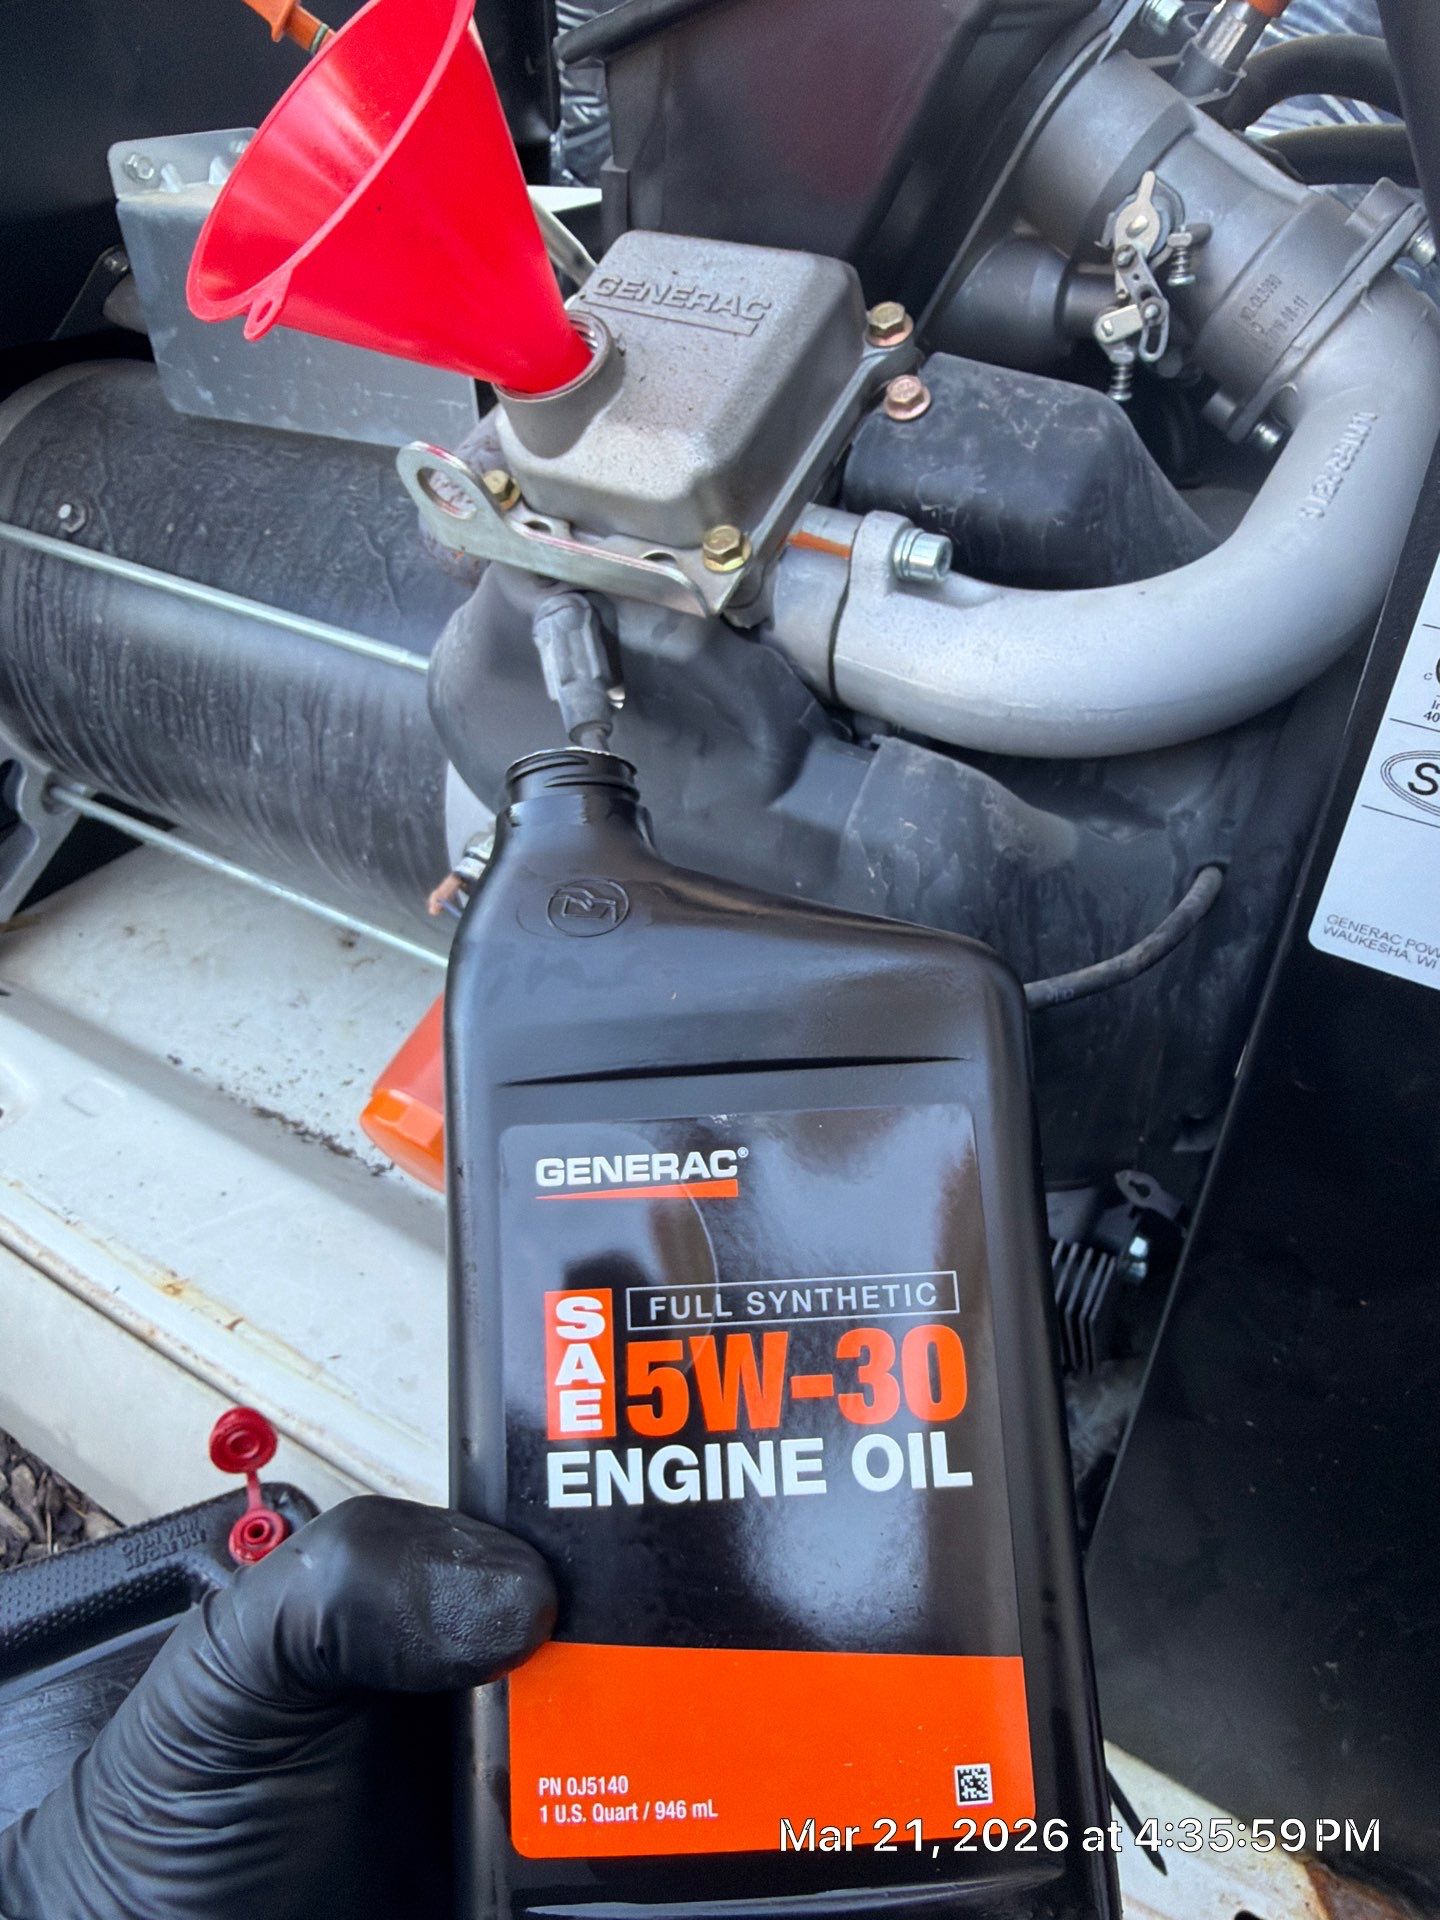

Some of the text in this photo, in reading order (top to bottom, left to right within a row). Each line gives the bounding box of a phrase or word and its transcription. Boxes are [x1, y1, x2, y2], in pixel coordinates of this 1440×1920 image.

[593, 276, 773, 322] GENERAC
[1326, 913, 1402, 945] GENERAC
[648, 1281, 938, 1321] FULL SYNTHETIC
[555, 1295, 606, 1433] SAE
[625, 1323, 968, 1437] 5W-30
[546, 1430, 974, 1509] ENGINE OIL
[538, 1775, 629, 1796] PN 0J5140
[540, 1798, 719, 1824] 1 U.S. Quart / 946 mL
